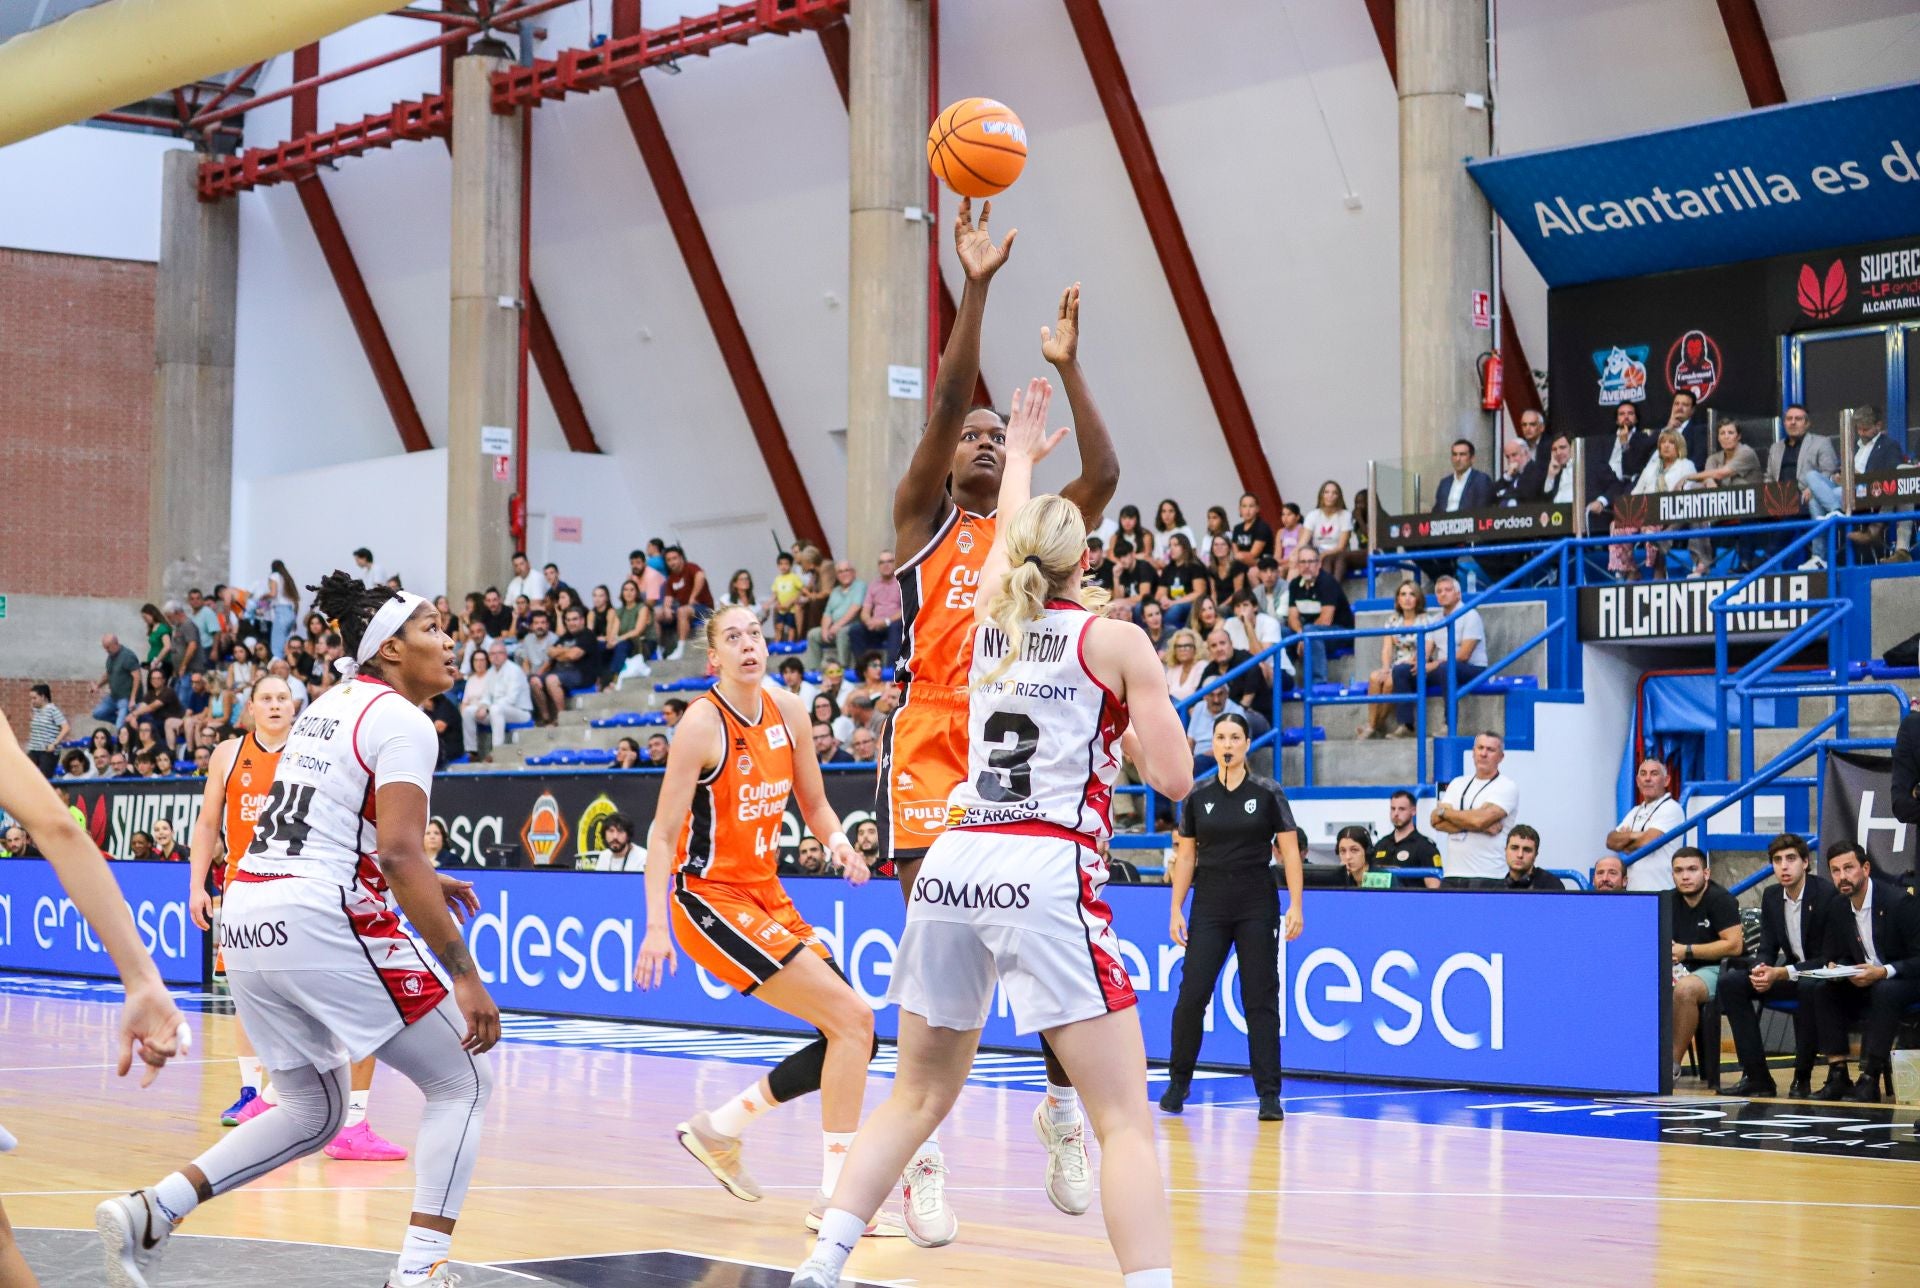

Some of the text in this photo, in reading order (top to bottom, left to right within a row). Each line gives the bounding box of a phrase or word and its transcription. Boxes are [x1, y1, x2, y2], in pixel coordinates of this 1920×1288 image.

[1534, 139, 1920, 238] Alcantarilla es d
[1892, 278, 1920, 295] end
[1600, 385, 1643, 402] AVENIDA
[1659, 488, 1755, 521] ALCANTARILLA
[1430, 517, 1474, 537] SUPERCOPA
[1494, 515, 1533, 531] endesa
[975, 711, 1040, 803] 3
[249, 780, 317, 857] 34
[914, 877, 1031, 910] SOMMOS
[33, 895, 187, 959] ensa
[221, 920, 289, 949] OMMOS
[450, 890, 633, 993] desa
[1661, 1126, 1900, 1149] GLOBAL
